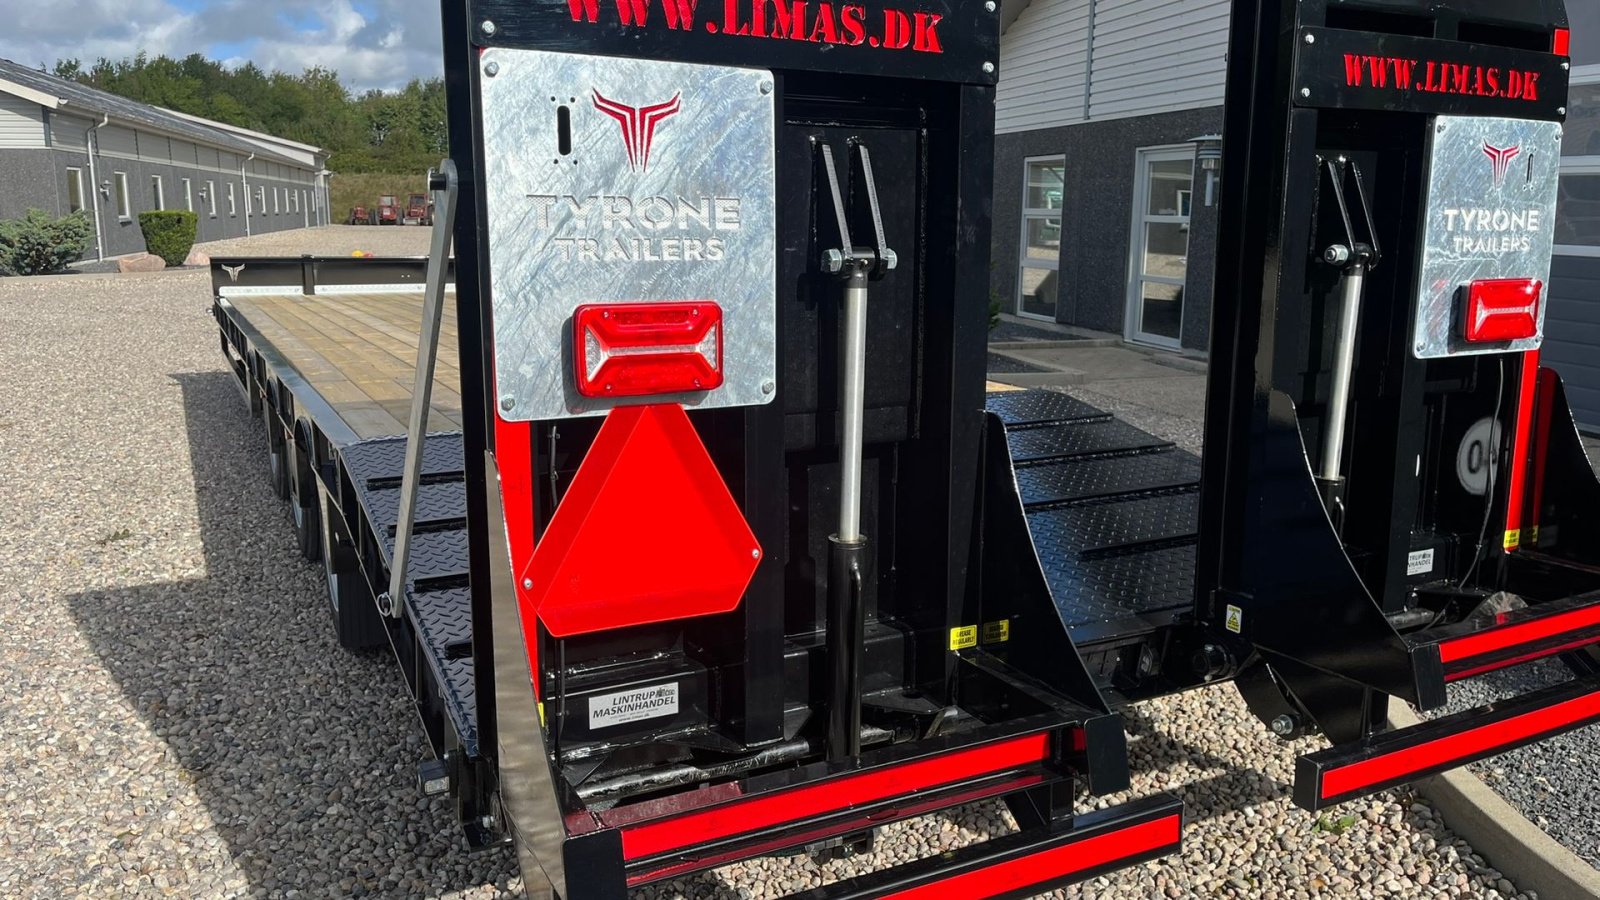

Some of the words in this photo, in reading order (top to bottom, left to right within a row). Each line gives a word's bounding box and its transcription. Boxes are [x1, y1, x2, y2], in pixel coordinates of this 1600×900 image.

[1343, 53, 1540, 101] WWW.LIMAS.DK
[526, 194, 741, 230] TYRONE
[1443, 208, 1540, 231] TYRONE
[554, 237, 725, 261] TRAILERS
[1453, 234, 1531, 252] TRAILERS
[593, 696, 676, 719] MASKINHANDEL
[612, 690, 656, 705] LINTRUP
